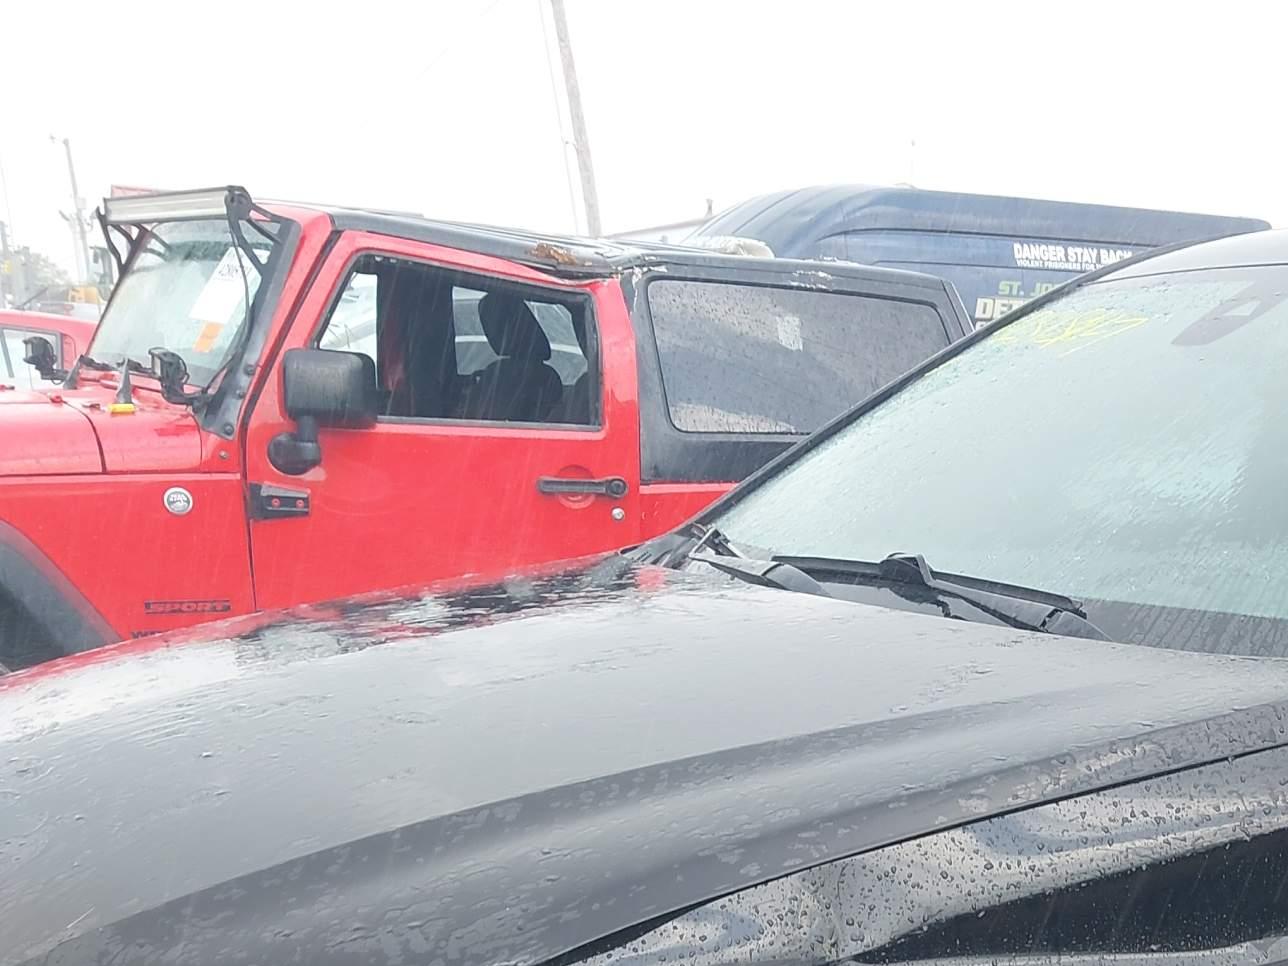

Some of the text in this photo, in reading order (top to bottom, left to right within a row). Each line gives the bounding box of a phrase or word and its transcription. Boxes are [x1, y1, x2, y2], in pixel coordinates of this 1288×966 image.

[1013, 243, 1065, 262] DANGER
[1067, 246, 1098, 263] STAY
[998, 280, 1057, 296] ST. JO
[145, 600, 231, 614] SPORT
